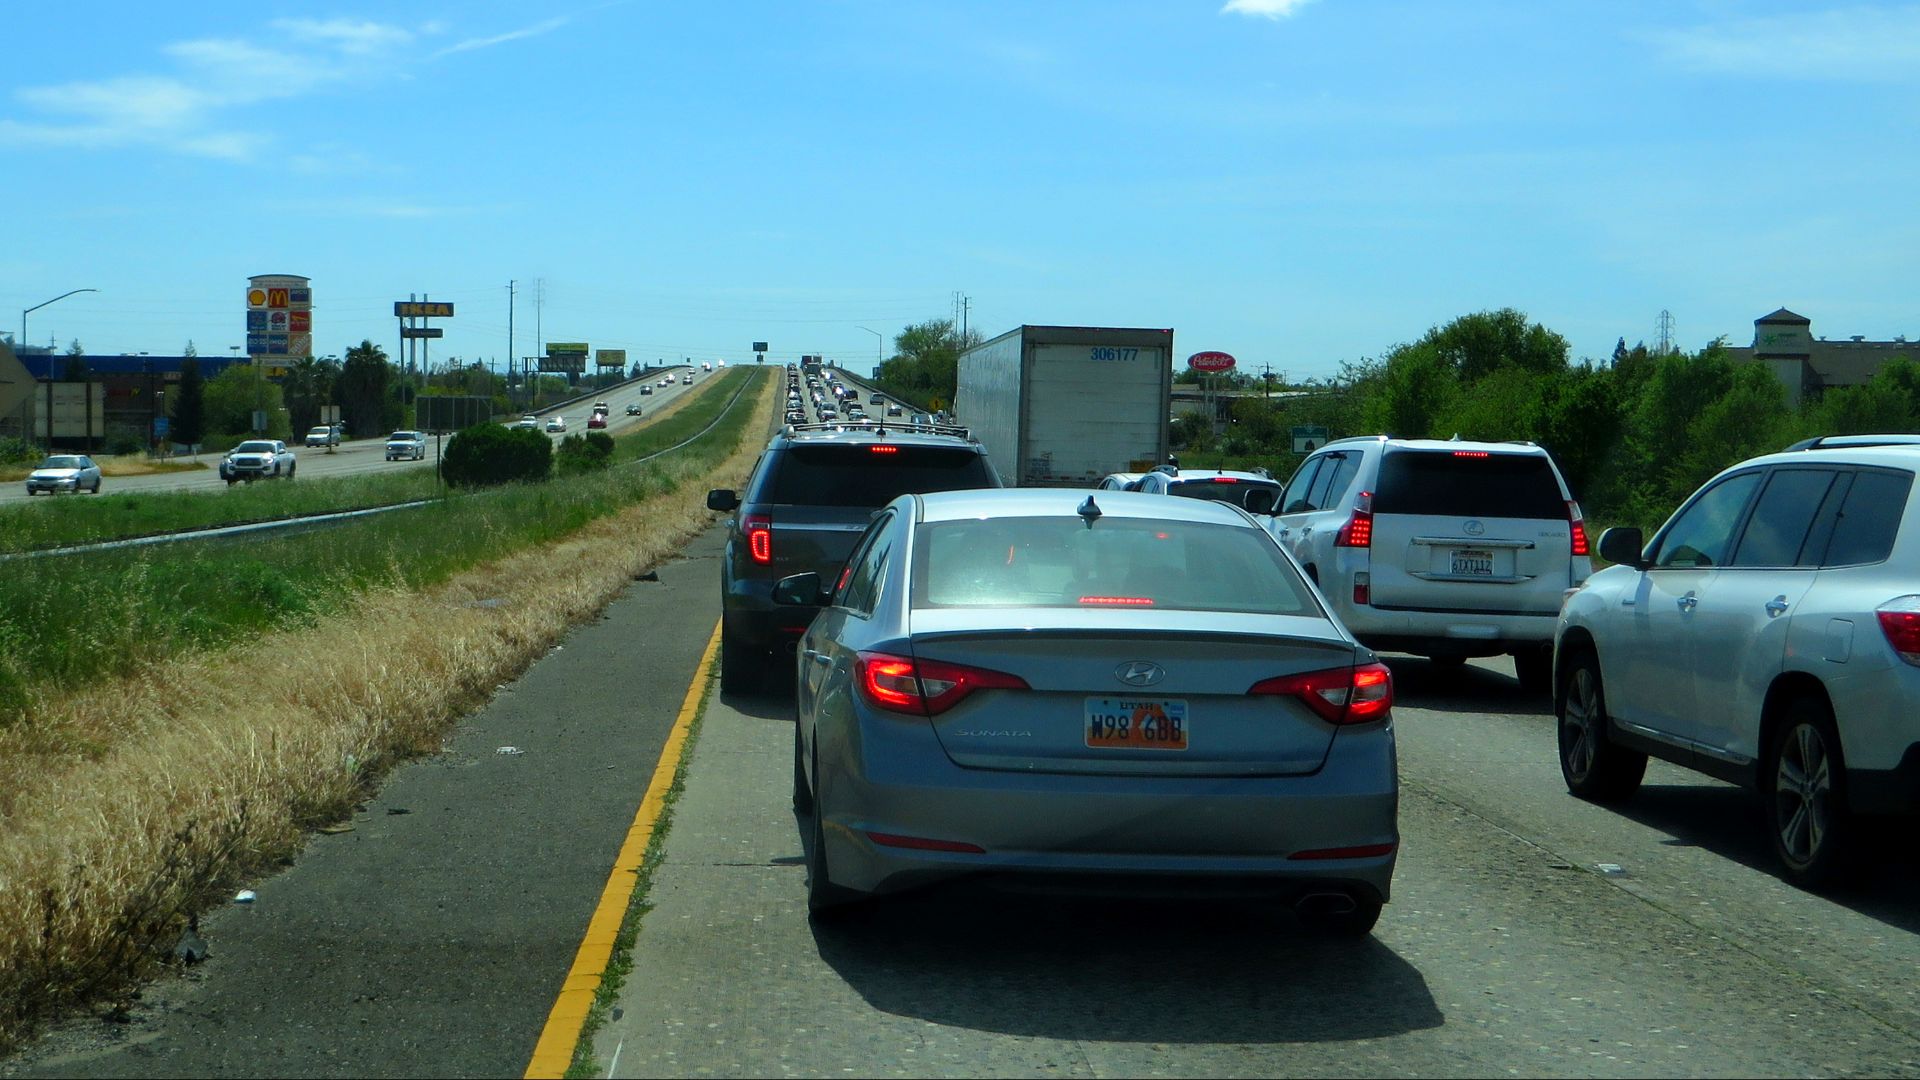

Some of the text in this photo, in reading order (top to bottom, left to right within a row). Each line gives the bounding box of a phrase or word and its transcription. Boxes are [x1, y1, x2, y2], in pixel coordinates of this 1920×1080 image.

[400, 304, 449, 315] IKEA
[1090, 347, 1139, 361] 306177
[1193, 355, 1232, 367] Peterbilt
[1120, 702, 1154, 711] UTAH
[953, 728, 1033, 737] SONATA
